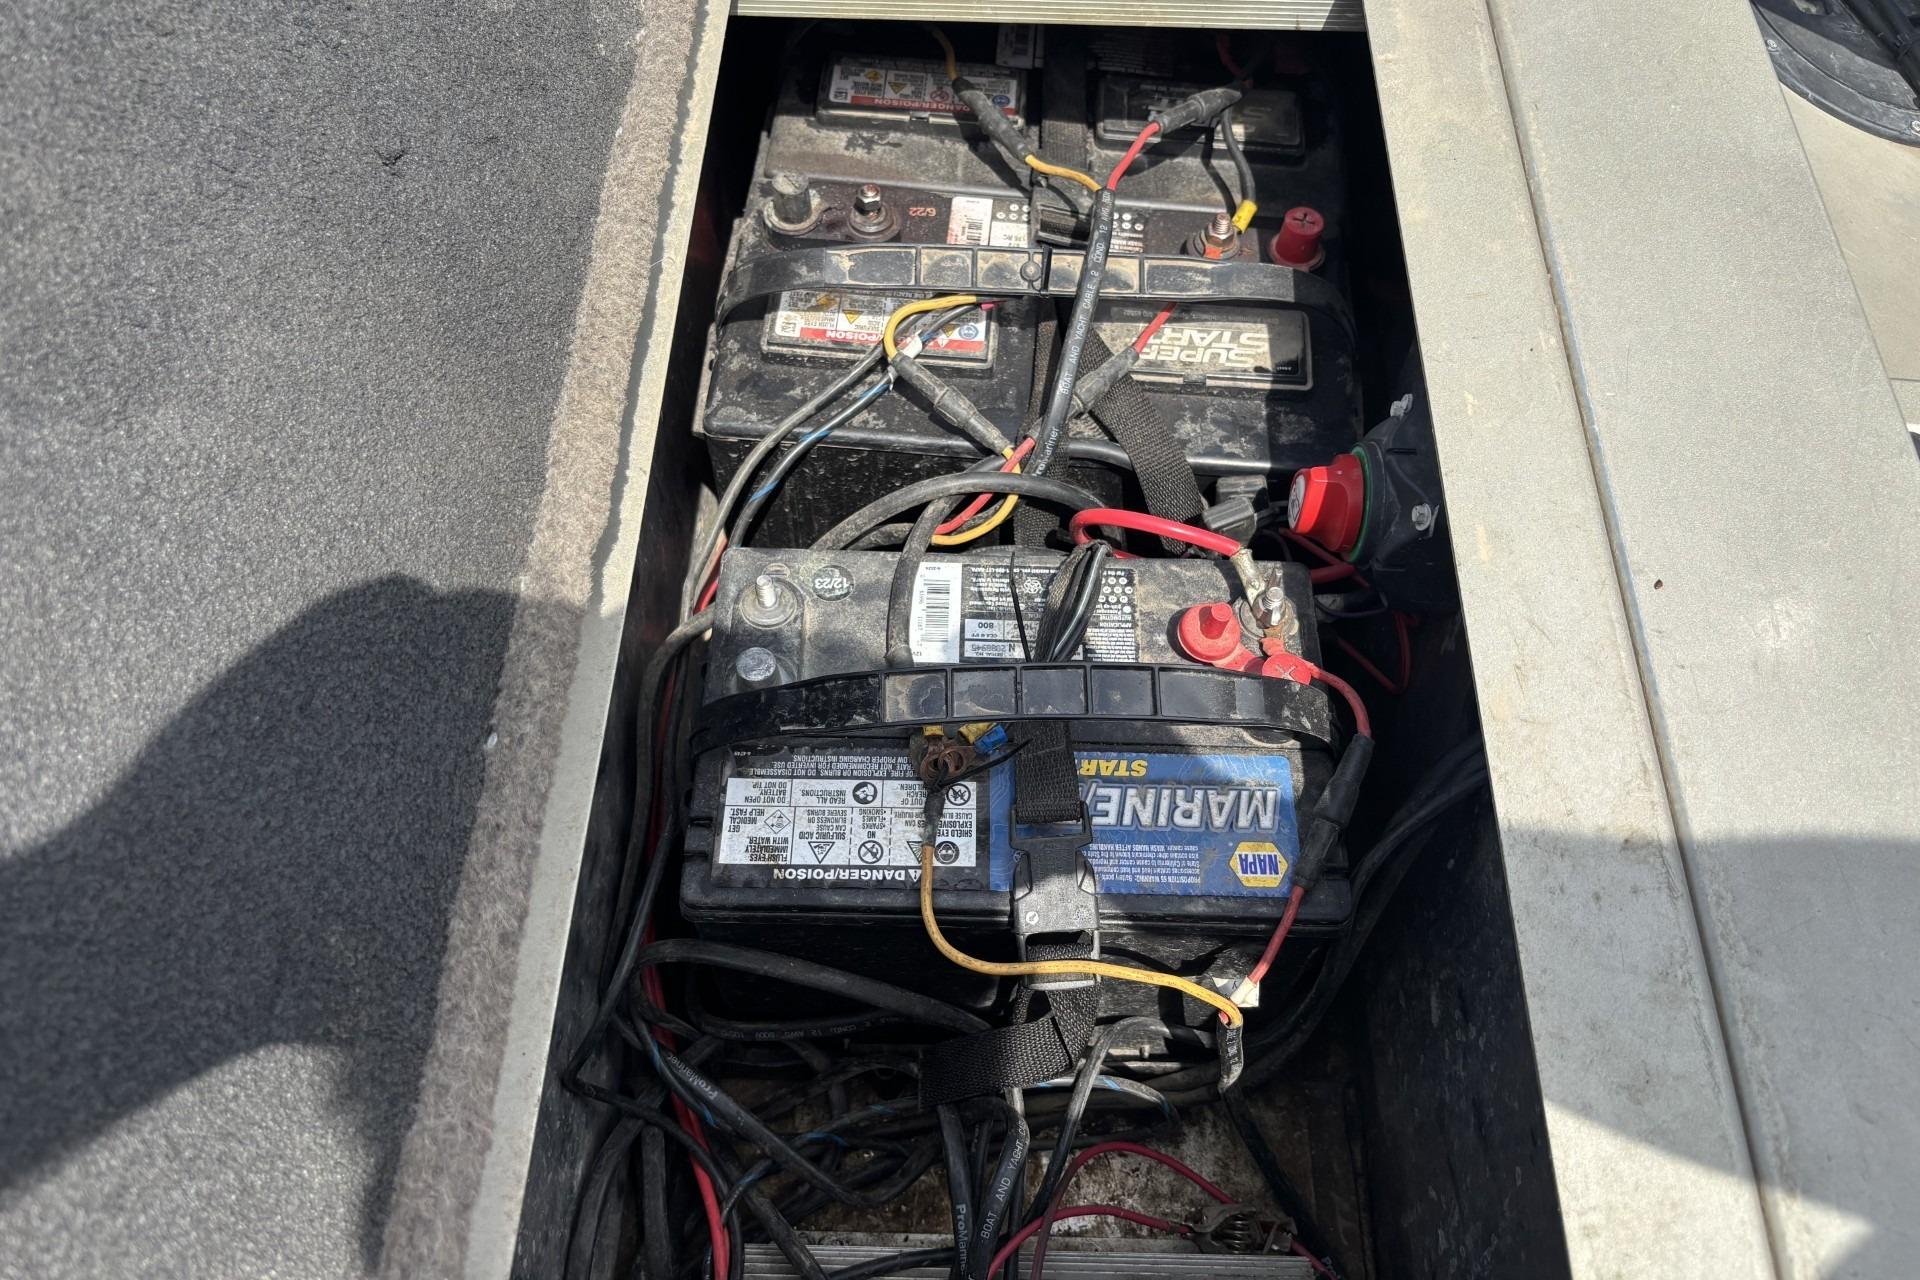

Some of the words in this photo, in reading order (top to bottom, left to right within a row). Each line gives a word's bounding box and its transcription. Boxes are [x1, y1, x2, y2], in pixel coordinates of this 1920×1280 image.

[908, 207, 936, 217] 6/22
[1061, 372, 1072, 395] BOAT
[1069, 345, 1080, 364] AND
[1075, 315, 1088, 340] YACHT
[1083, 284, 1096, 309] CABLE
[1099, 224, 1108, 234] 12
[825, 330, 883, 341] /POISON
[814, 576, 850, 589] 12/23
[791, 754, 838, 762] INSTRUCTIONS.
[871, 755, 896, 763] PROPER
[787, 761, 817, 769] INVERTED
[832, 762, 878, 770] RECOMMENDED
[879, 762, 893, 770] NOT
[1077, 759, 1148, 777] STAR
[794, 768, 806, 776] NOT
[808, 768, 816, 776] DO
[764, 781, 777, 789] NOT
[778, 781, 787, 789] DO
[759, 788, 787, 796] BATTERY.
[816, 796, 828, 804] ALL
[828, 796, 846, 804] READ
[900, 797, 906, 805] OF
[908, 797, 924, 805] OUT
[1079, 782, 1277, 829] MARINE/
[730, 808, 748, 816] FAST.
[749, 808, 765, 816] HELP
[729, 816, 757, 824] MEDICAL
[807, 816, 816, 824] OR
[817, 816, 847, 824] BLINDNESS
[728, 824, 740, 832] GET
[939, 820, 972, 829] EXPLOSIVE
[798, 831, 814, 840] ACID
[815, 832, 846, 840] SULFURIC
[867, 830, 876, 839] NO
[937, 829, 949, 837] EYE
[951, 829, 972, 837] SHIELD
[746, 836, 771, 844] WATER.
[772, 836, 788, 844] WITH
[745, 845, 789, 853] IMMEDIATELY
[1149, 844, 1165, 852] WASH
[749, 854, 766, 862] EYES
[766, 854, 788, 862] FLUSH
[1087, 850, 1100, 858] State
[1186, 860, 1200, 868] State
[1238, 853, 1280, 876] NAPA
[773, 867, 906, 881] DANGER/POISON
[1134, 874, 1160, 883] WARNING:
[1168, 875, 1201, 883] PROPOSITION
[667, 1055, 719, 1100] ProMariner
[980, 1211, 998, 1240] BOAT
[996, 1177, 1012, 1202] AND
[1007, 1139, 1024, 1170] YACHT
